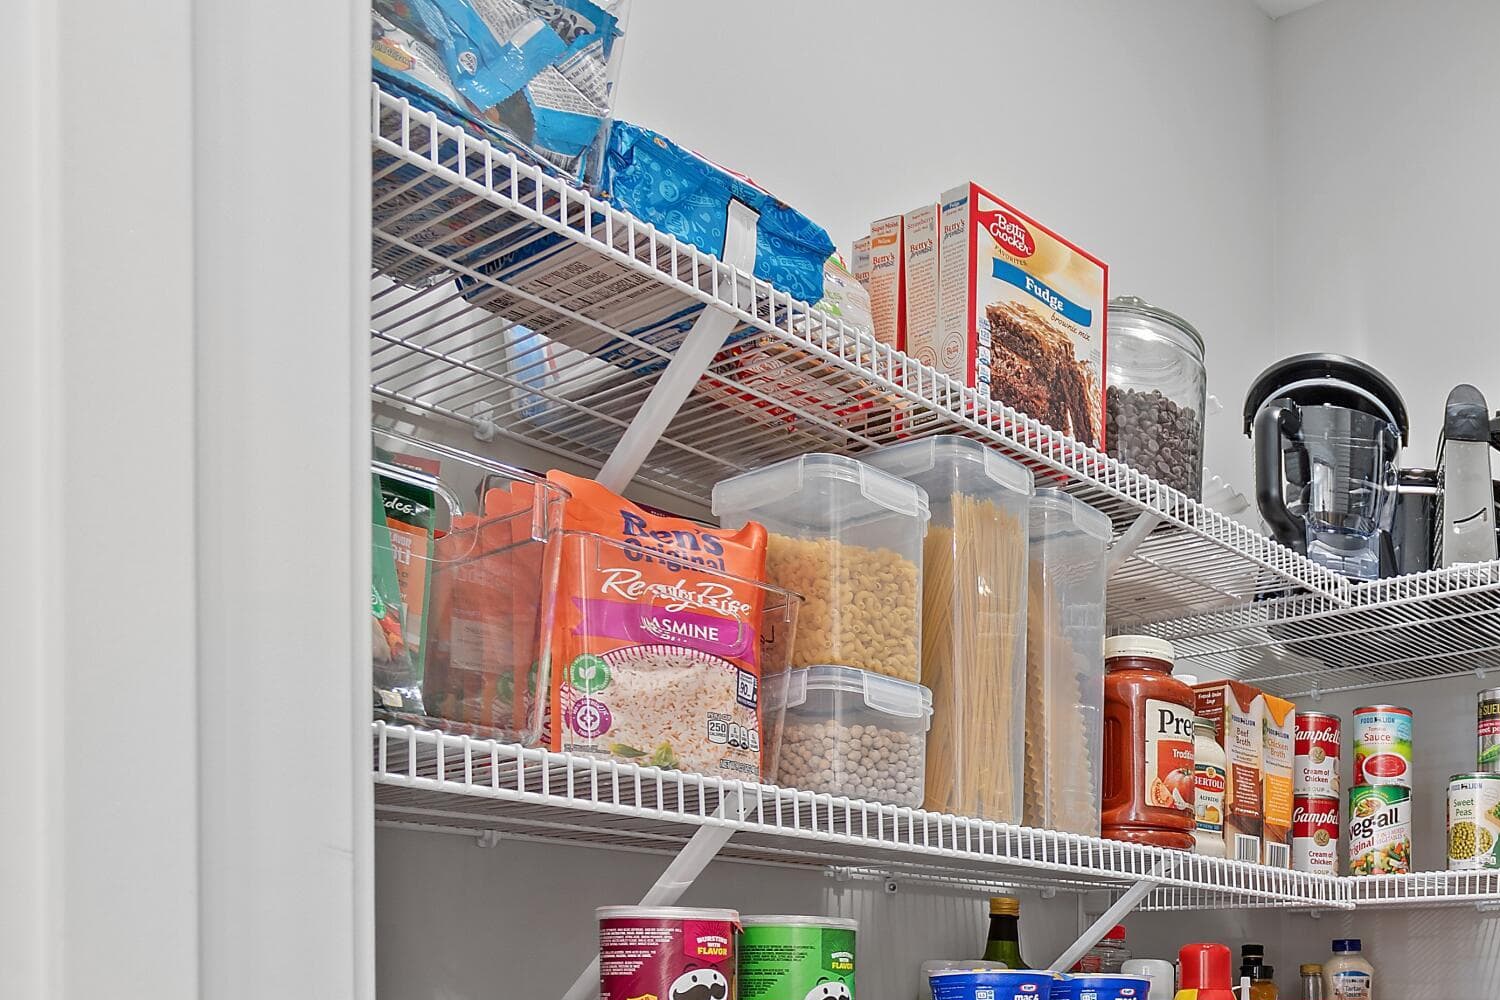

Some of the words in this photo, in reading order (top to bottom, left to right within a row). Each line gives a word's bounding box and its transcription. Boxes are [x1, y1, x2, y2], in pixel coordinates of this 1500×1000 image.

[994, 212, 1026, 244] Betty
[990, 222, 1032, 256] Crocker
[1025, 276, 1064, 312] Fudge
[1050, 312, 1078, 334] brownie
[1078, 328, 1091, 342] mix
[620, 508, 725, 557] Ben's
[623, 538, 726, 573] Original
[600, 568, 696, 613] Ready
[640, 616, 720, 643] JASMINE
[1236, 728, 1249, 738] Beef
[1364, 732, 1391, 742] Sauce
[1236, 736, 1251, 746] Broth
[1270, 748, 1286, 758] Broth
[1304, 776, 1329, 784] Chicken
[1453, 798, 1475, 807] Sweet
[1455, 808, 1473, 817] Peas
[1310, 858, 1332, 866] Chicken
[697, 946, 728, 956] FLAVOR
